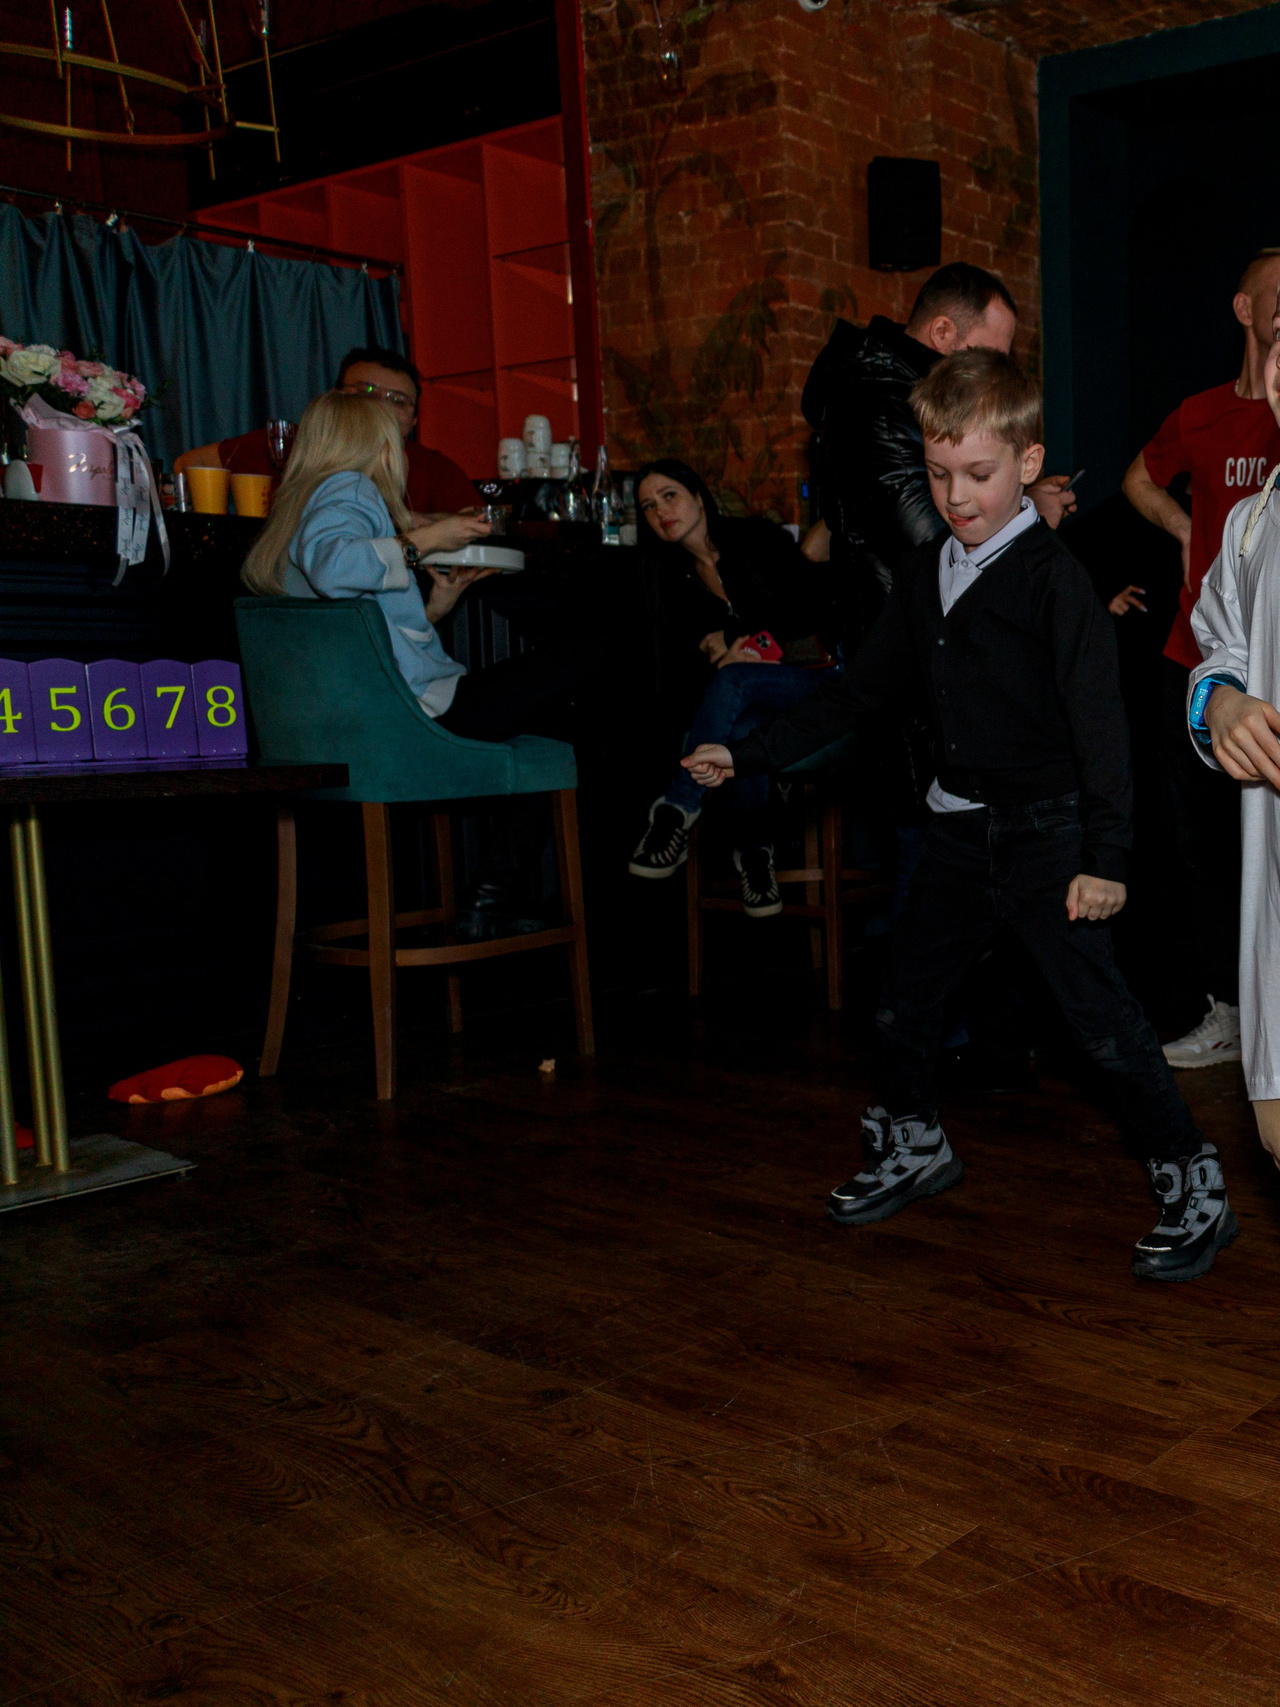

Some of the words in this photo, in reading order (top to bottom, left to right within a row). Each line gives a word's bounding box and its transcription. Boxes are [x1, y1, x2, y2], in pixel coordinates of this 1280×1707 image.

[1225, 457, 1267, 487] СОУС
[0, 687, 22, 734] 4
[49, 686, 82, 732] 5
[103, 687, 136, 731] 6
[156, 686, 186, 729] 7
[206, 685, 237, 728] 8
